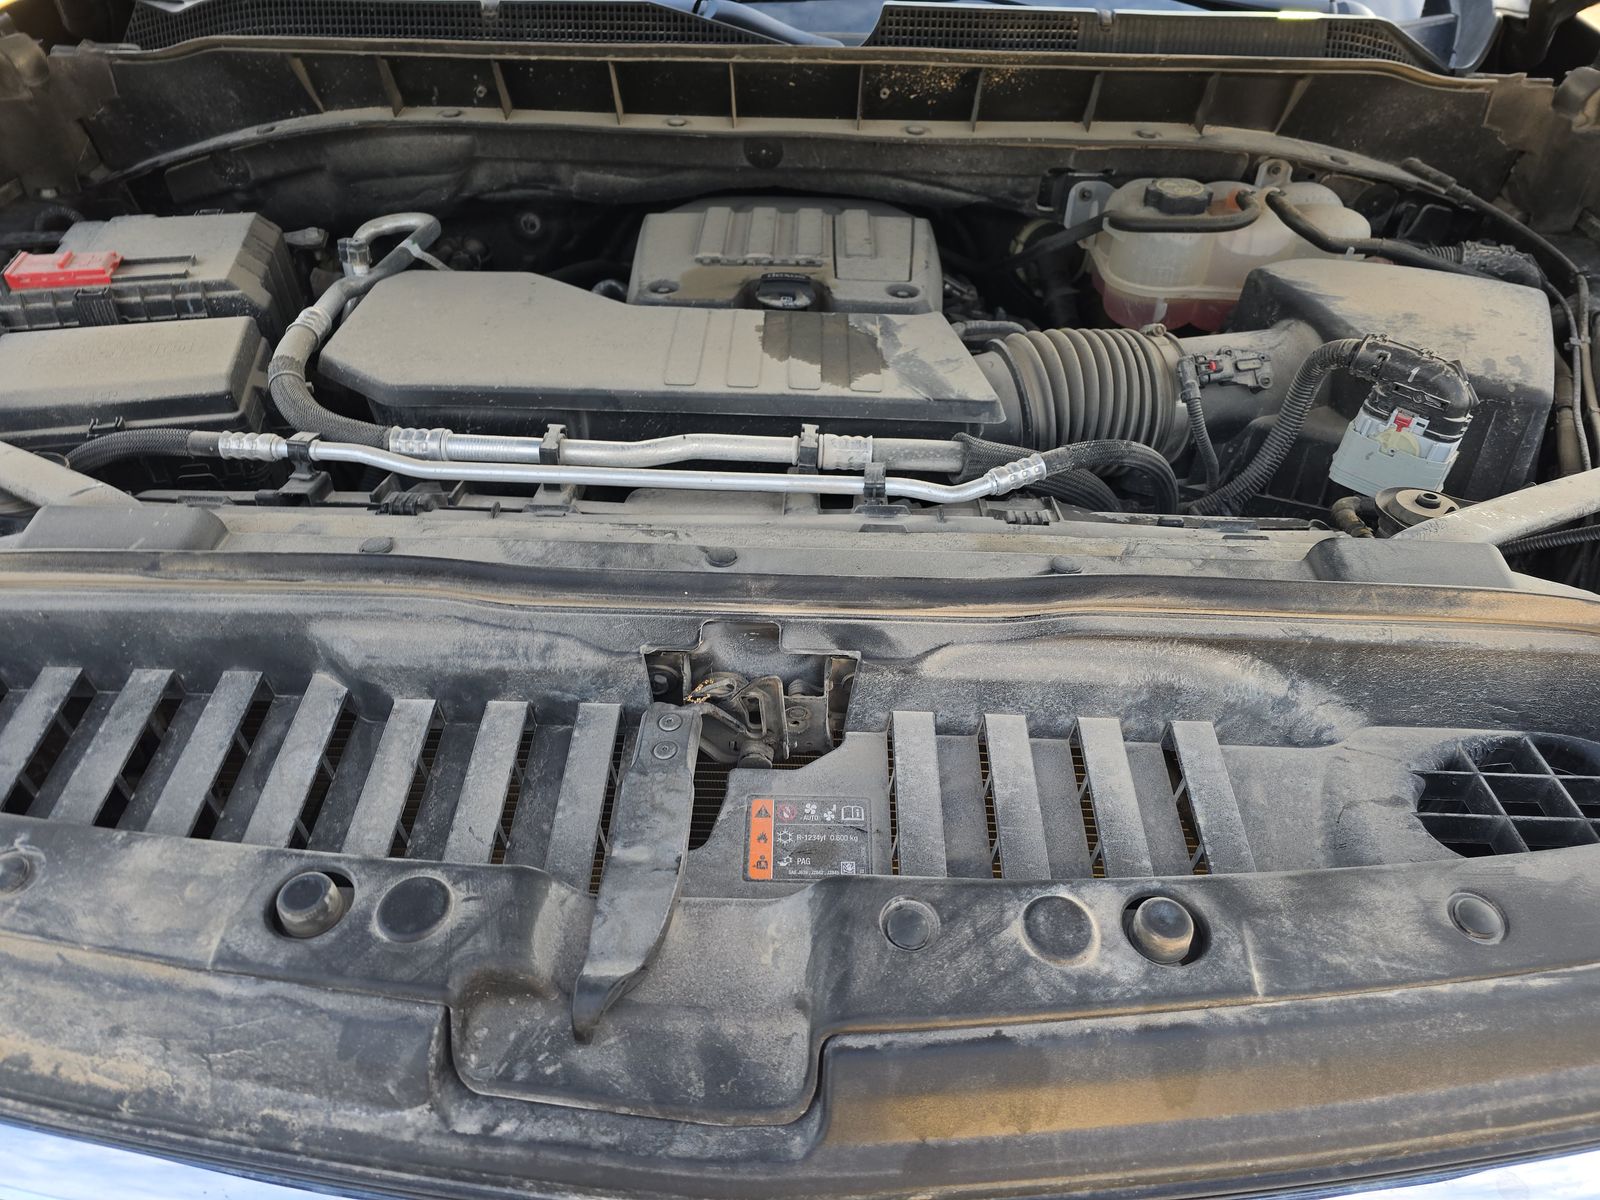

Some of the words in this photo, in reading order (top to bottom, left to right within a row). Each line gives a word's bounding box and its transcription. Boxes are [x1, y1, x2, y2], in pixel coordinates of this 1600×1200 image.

[796, 834, 826, 843] R-1234yf
[850, 834, 859, 844] kg
[796, 857, 811, 865] PAG
